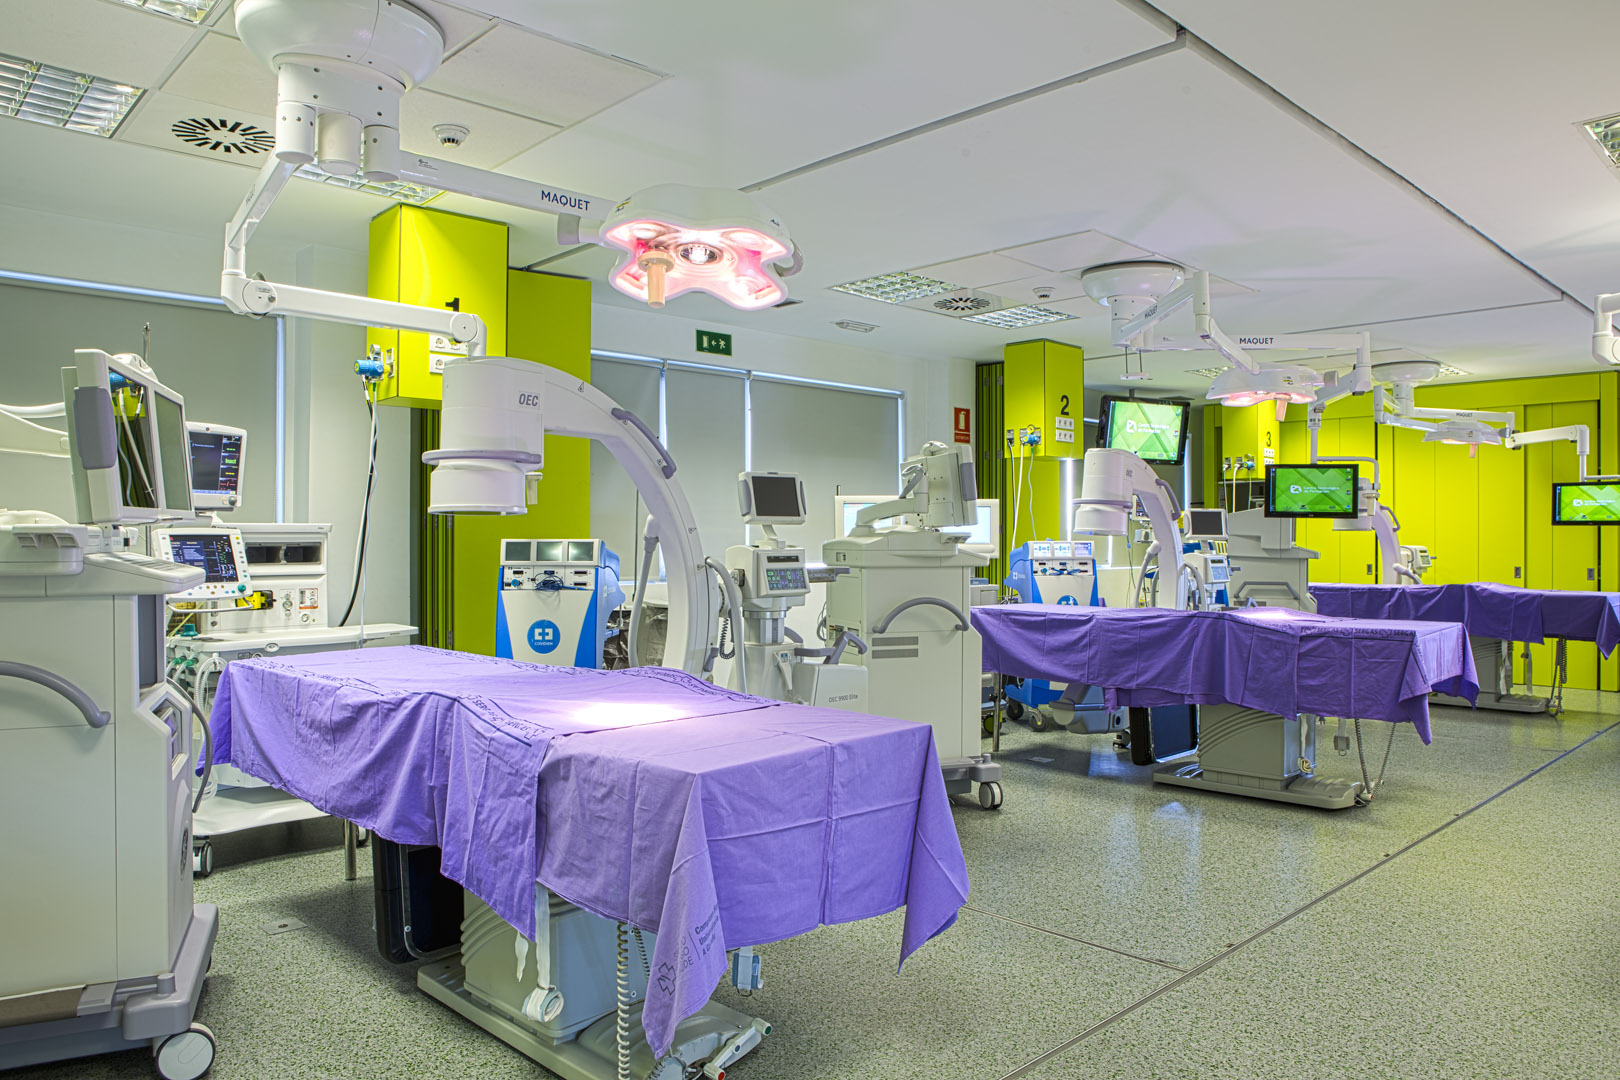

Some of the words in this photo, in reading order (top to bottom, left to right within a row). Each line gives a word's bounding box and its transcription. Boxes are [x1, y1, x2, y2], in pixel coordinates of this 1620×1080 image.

[541, 190, 590, 211] MAQUET
[1239, 337, 1274, 345] MAQUET
[518, 393, 539, 407] OEC
[1060, 394, 1070, 416] 2
[1266, 431, 1272, 447] 3
